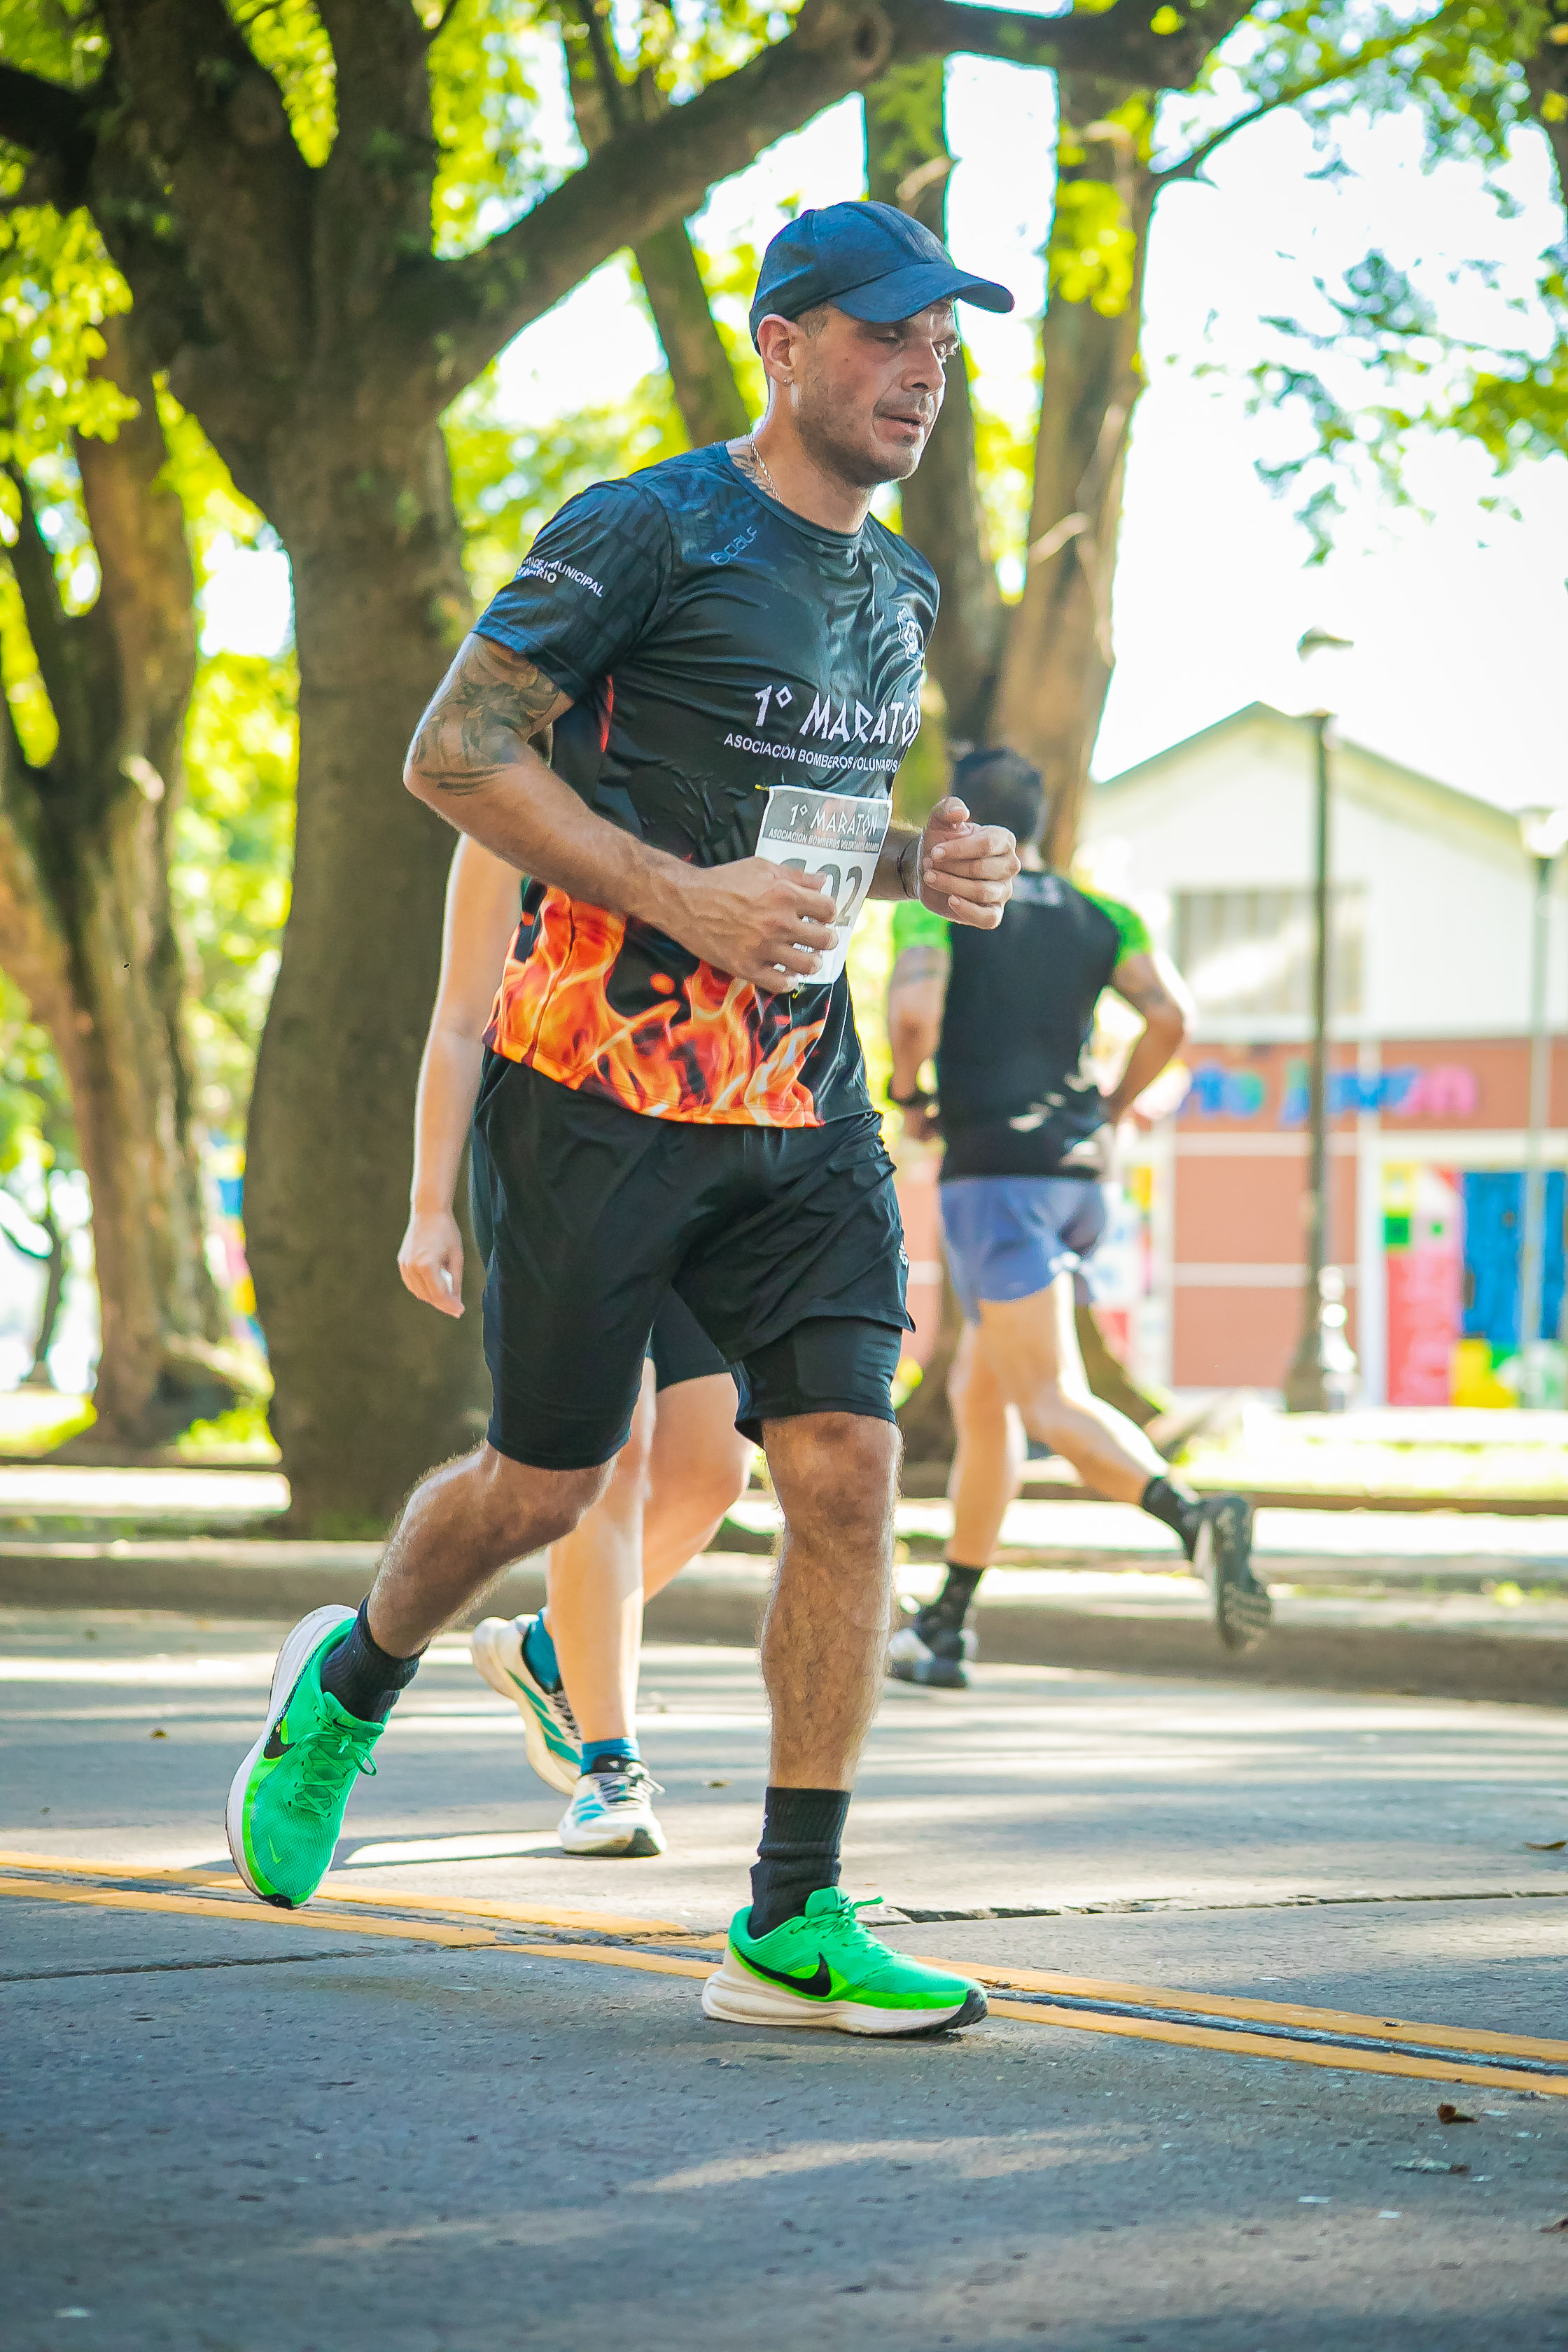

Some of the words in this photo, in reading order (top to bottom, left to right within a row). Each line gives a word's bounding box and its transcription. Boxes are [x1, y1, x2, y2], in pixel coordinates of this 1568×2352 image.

[547, 559, 603, 598] MUNICIPAL
[798, 748, 853, 770] BOMBEROS
[810, 806, 878, 837] MARATÓN
[768, 826, 808, 844] ASOCIACIÓN
[807, 834, 841, 850] BOMBEROS
